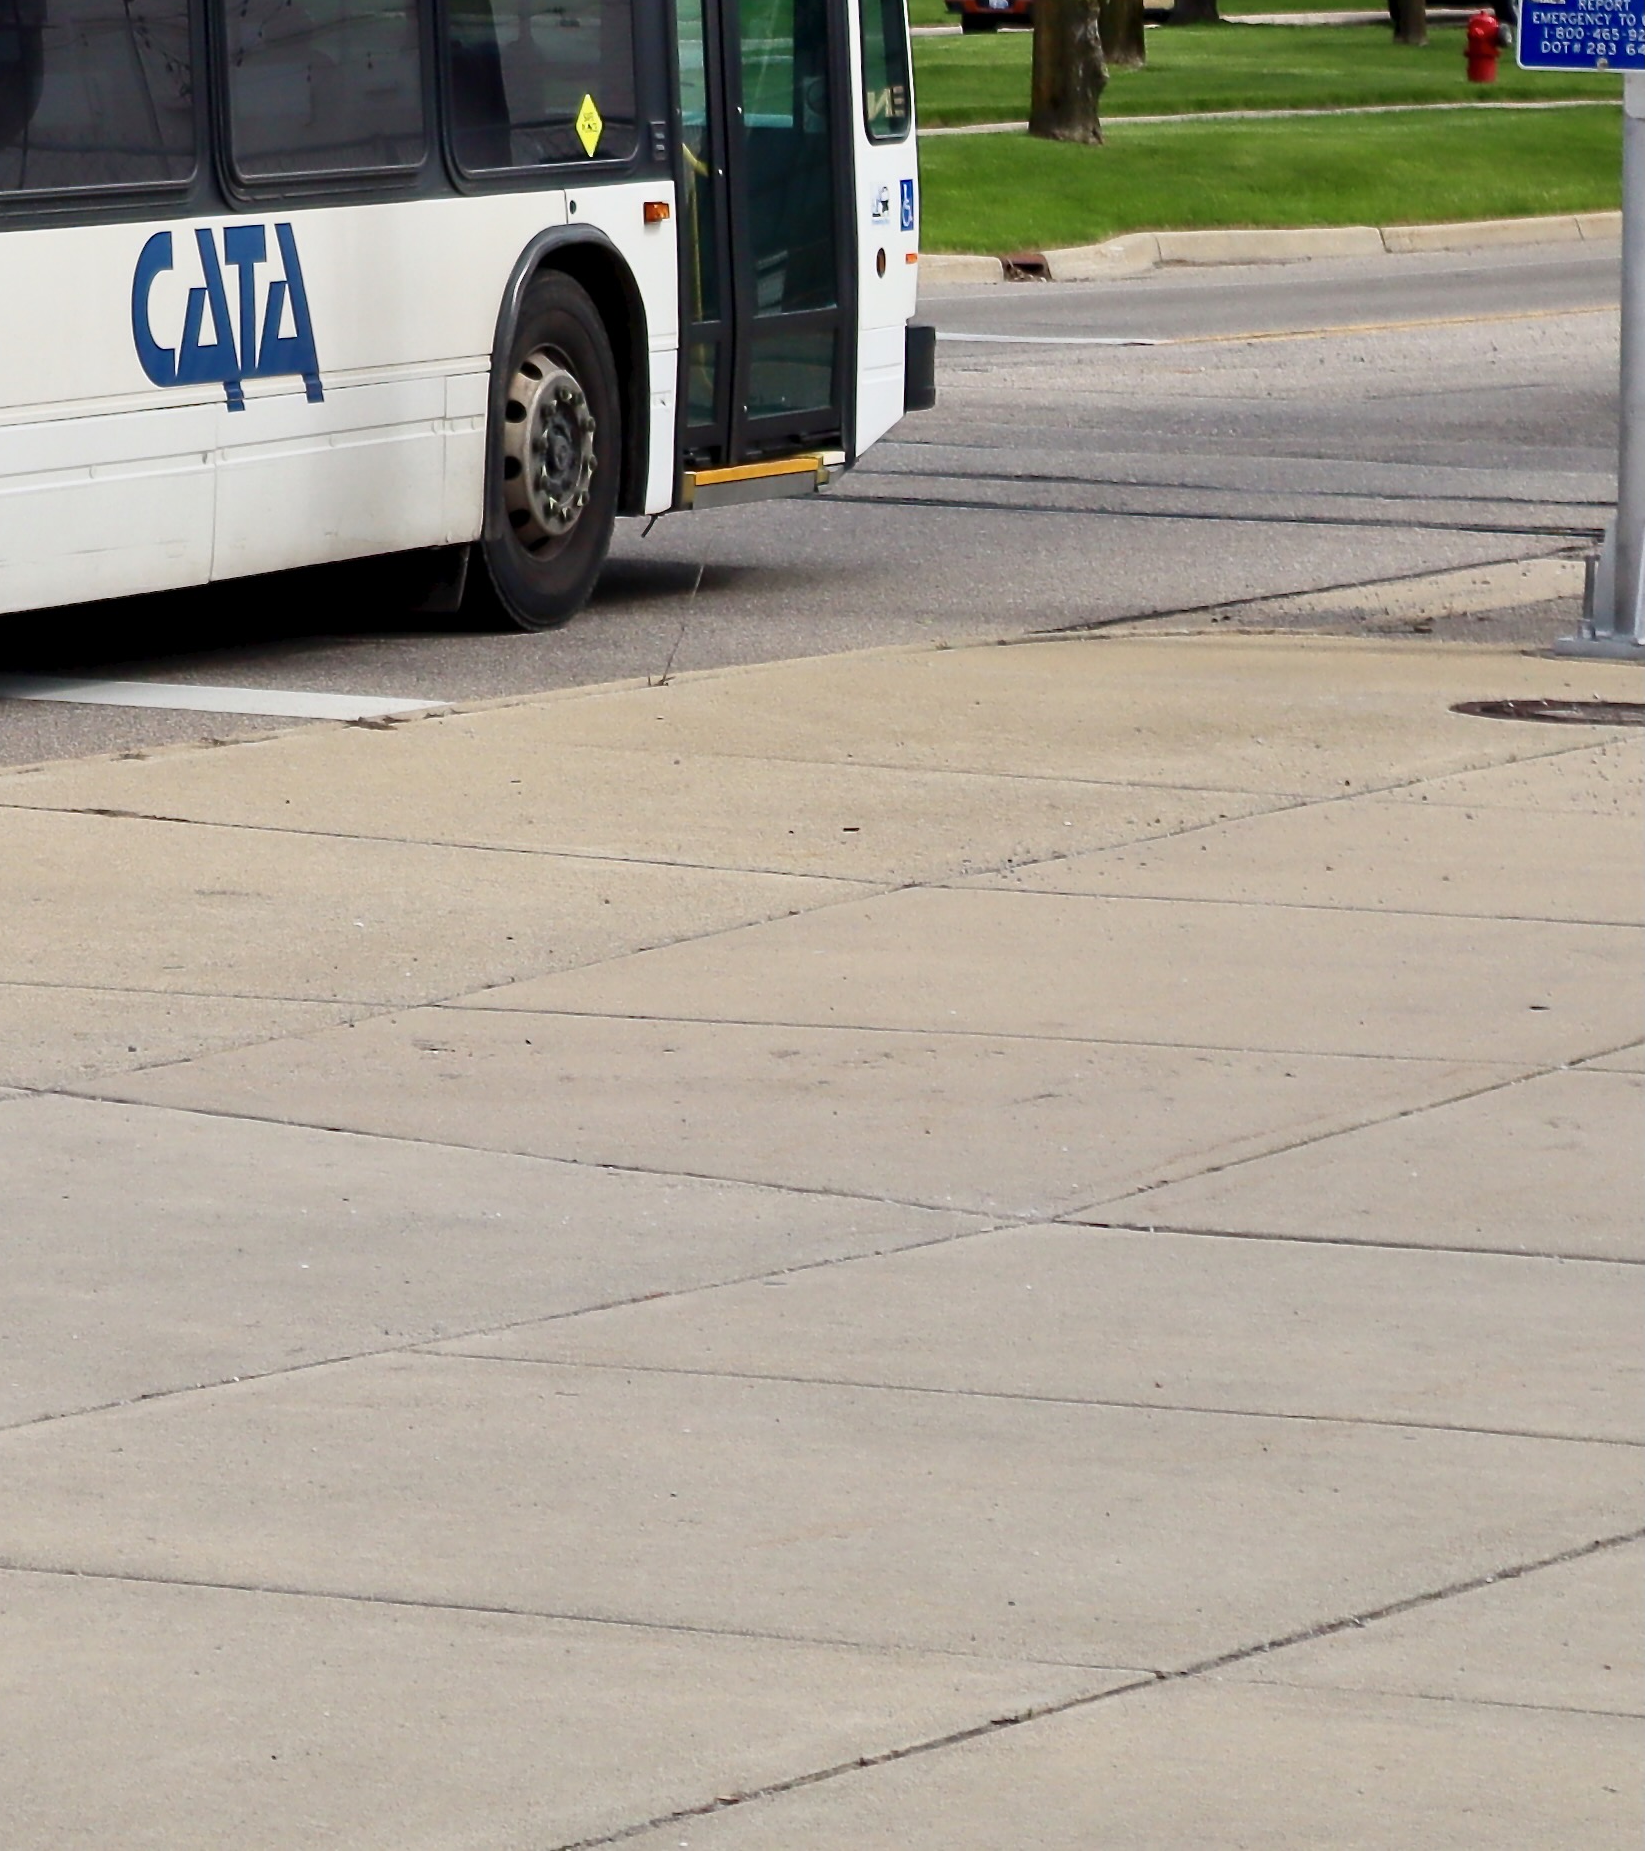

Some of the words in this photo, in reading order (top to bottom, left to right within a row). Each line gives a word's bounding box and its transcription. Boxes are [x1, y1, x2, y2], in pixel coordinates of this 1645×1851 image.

[1532, 11, 1612, 26] EMERGENCY
[1618, 13, 1636, 27] TO
[1586, 42, 1617, 56] 283
[131, 222, 325, 413] CATA
